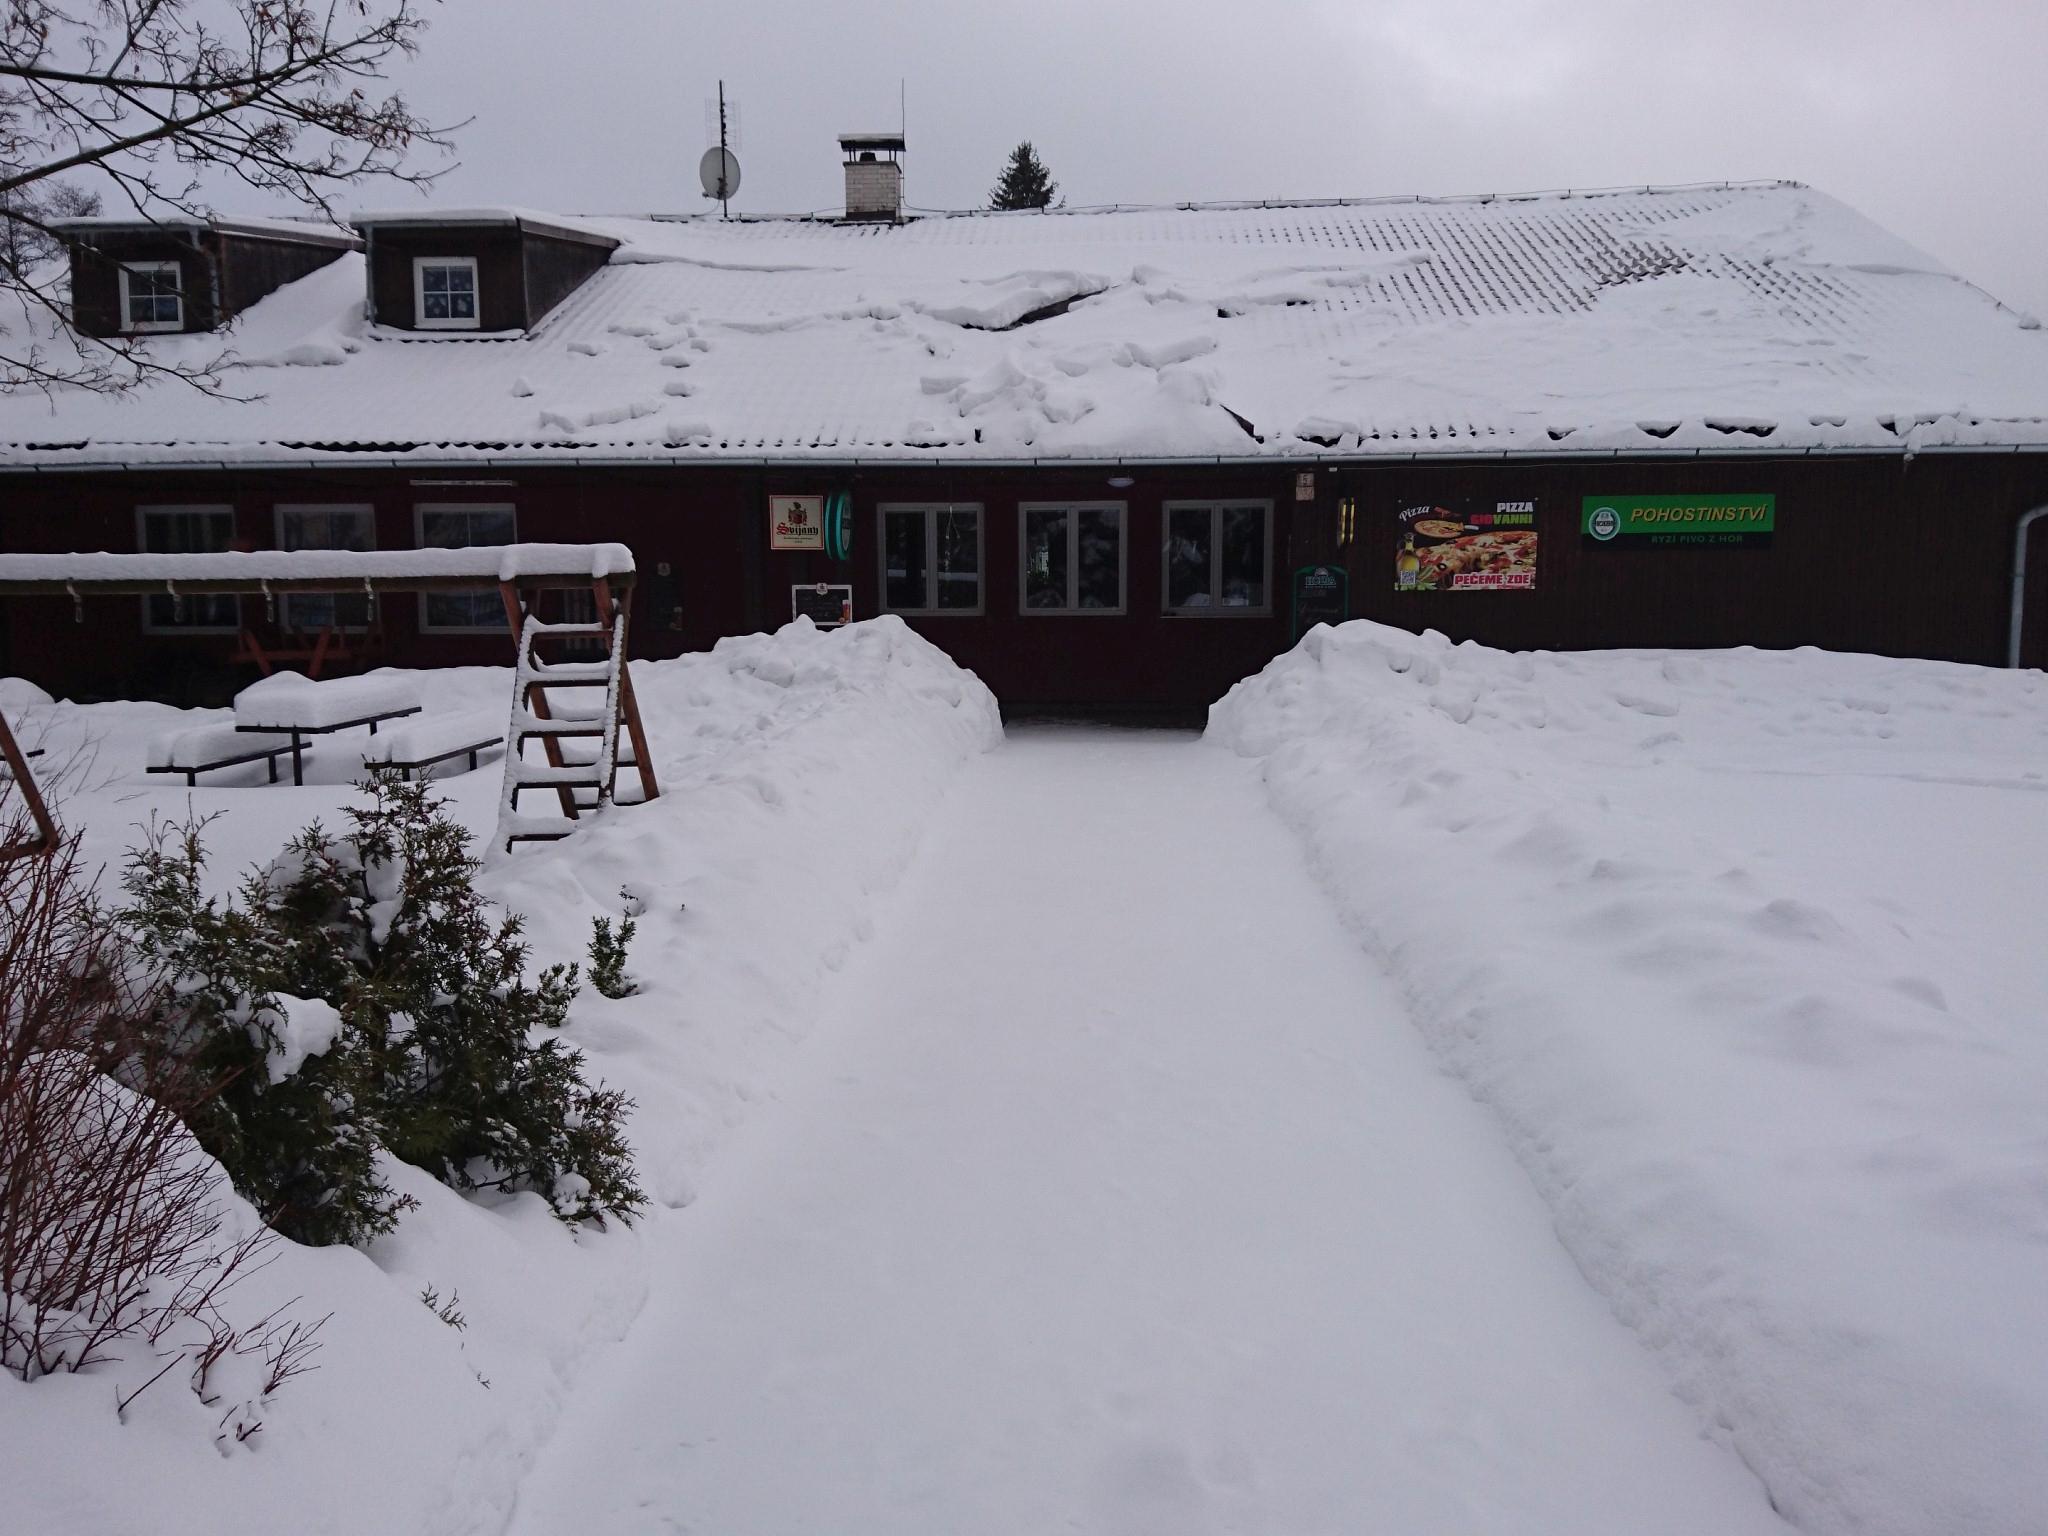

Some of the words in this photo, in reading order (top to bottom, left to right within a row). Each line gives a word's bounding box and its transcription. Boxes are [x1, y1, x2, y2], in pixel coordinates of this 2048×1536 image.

[1399, 505, 1430, 522] Pizza
[1496, 502, 1534, 513] PIZZA
[1631, 503, 1767, 522] POHOSTINSTVÍ
[776, 522, 819, 536] Svijany
[1680, 535, 1705, 544] PIVO
[1454, 572, 1503, 585] PEČEME
[1507, 574, 1530, 585] ZDE
